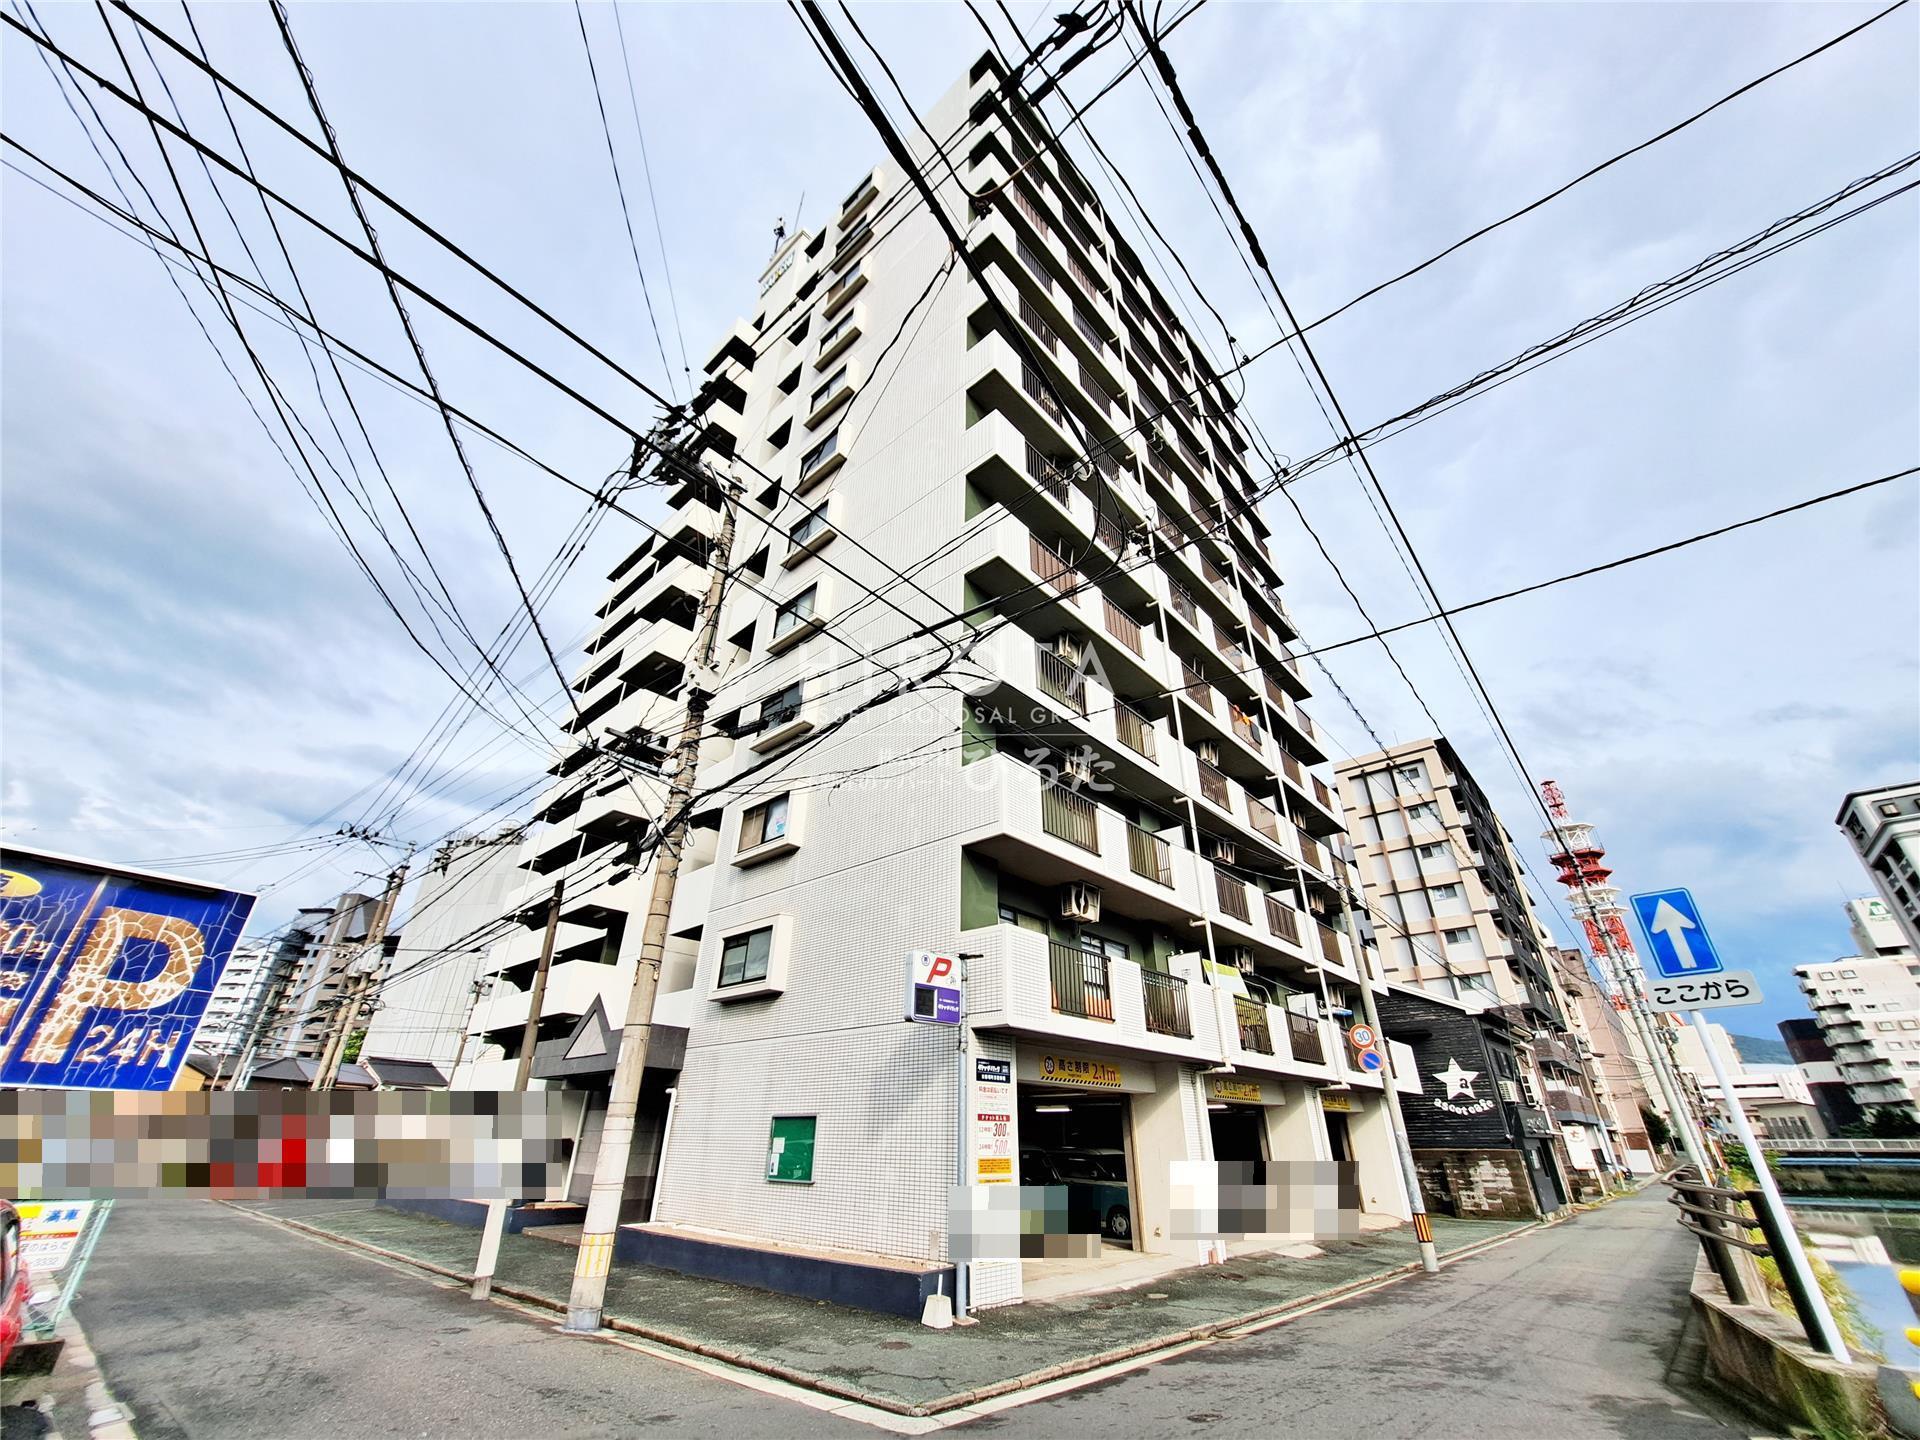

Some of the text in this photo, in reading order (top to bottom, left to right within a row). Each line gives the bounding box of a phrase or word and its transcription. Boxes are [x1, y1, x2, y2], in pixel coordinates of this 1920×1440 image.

[926, 957, 952, 984] P
[20, 905, 205, 1065] P
[1654, 979, 1750, 1005] ここから
[74, 1024, 182, 1068] 24H
[1355, 1030, 1370, 1043] 30
[1092, 1062, 1117, 1082] 2.1m
[1459, 1077, 1470, 1089] a
